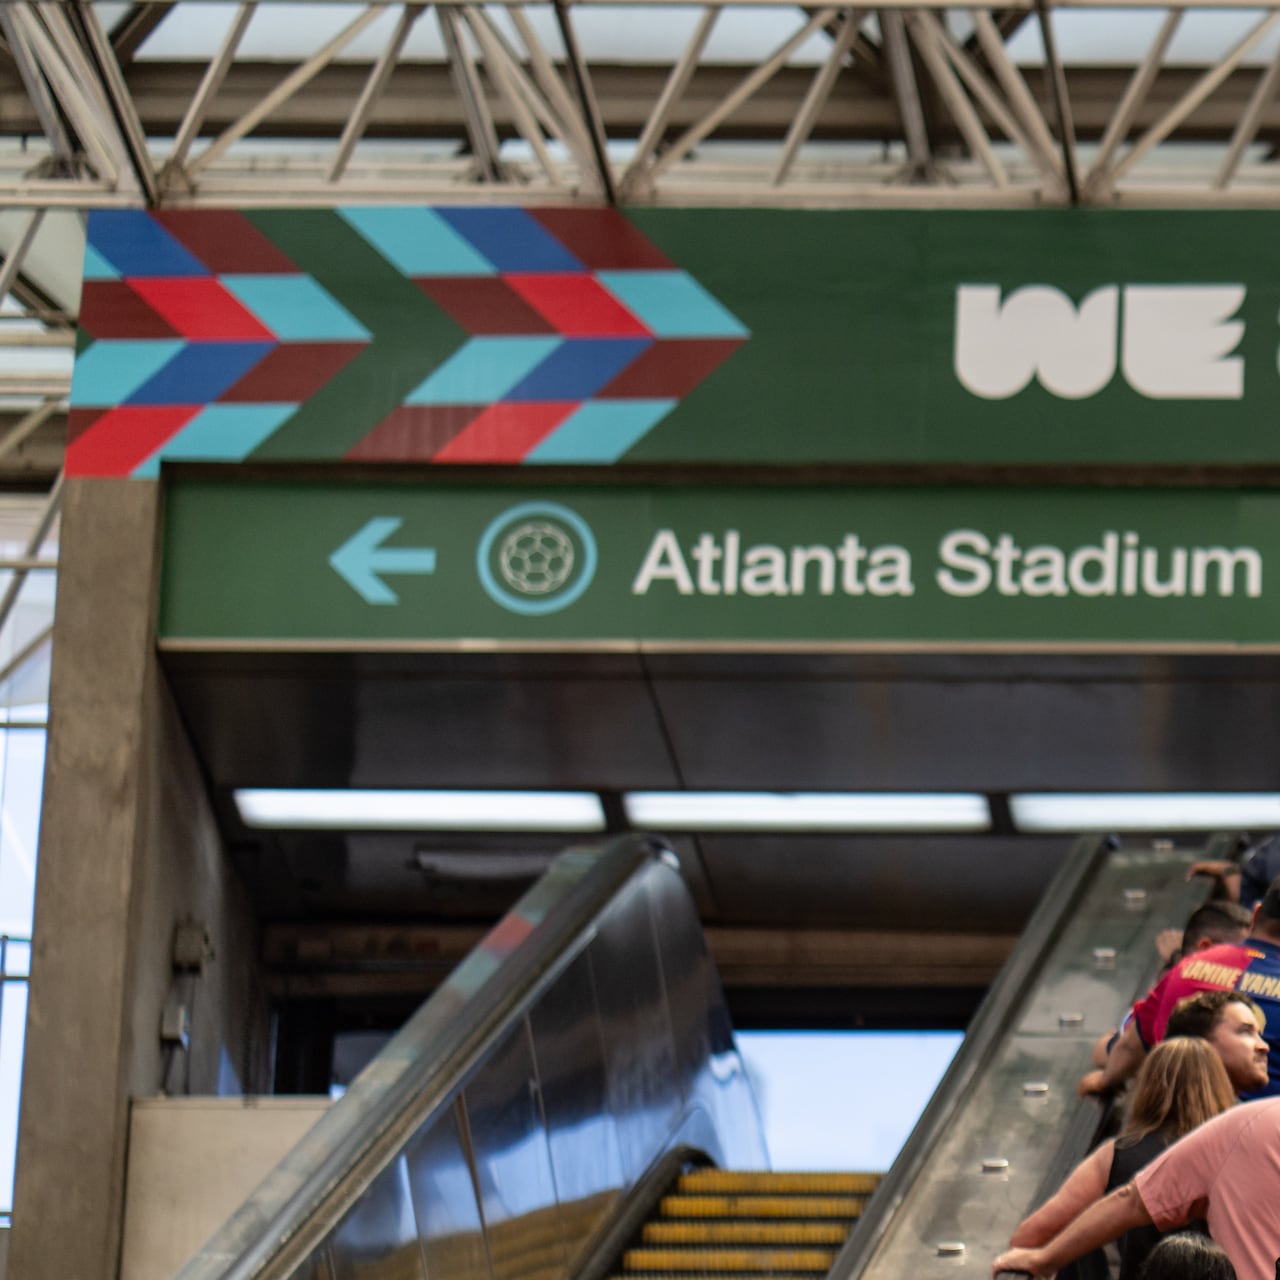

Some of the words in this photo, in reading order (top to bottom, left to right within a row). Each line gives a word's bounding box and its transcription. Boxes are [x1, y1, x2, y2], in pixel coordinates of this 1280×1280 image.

[955, 284, 1247, 400] WE
[632, 530, 917, 598] Atlanta
[936, 530, 1264, 599] Stadium
